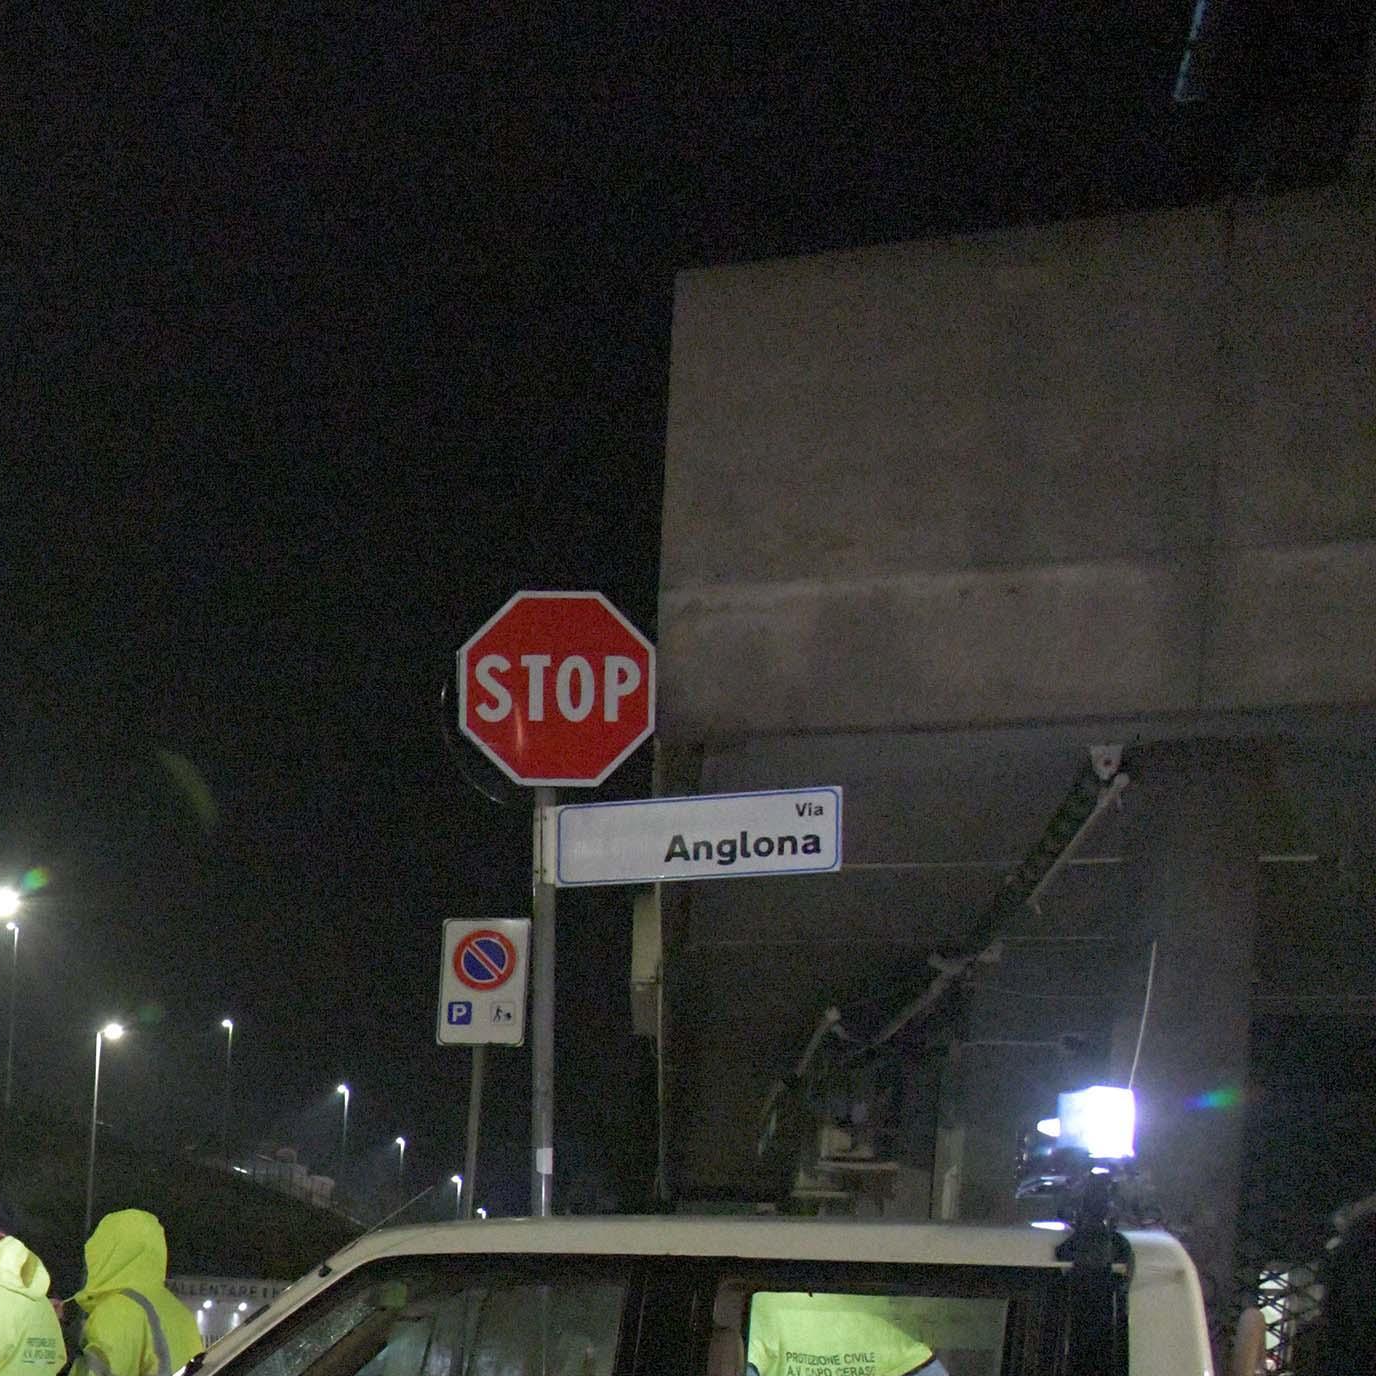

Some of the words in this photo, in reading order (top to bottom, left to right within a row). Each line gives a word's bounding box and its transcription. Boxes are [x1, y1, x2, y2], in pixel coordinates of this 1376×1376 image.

[475, 654, 641, 722] STOP
[795, 802, 824, 817] Via
[664, 831, 822, 865] Anglona
[451, 1004, 469, 1022] P
[843, 1352, 875, 1364] CIVILE
